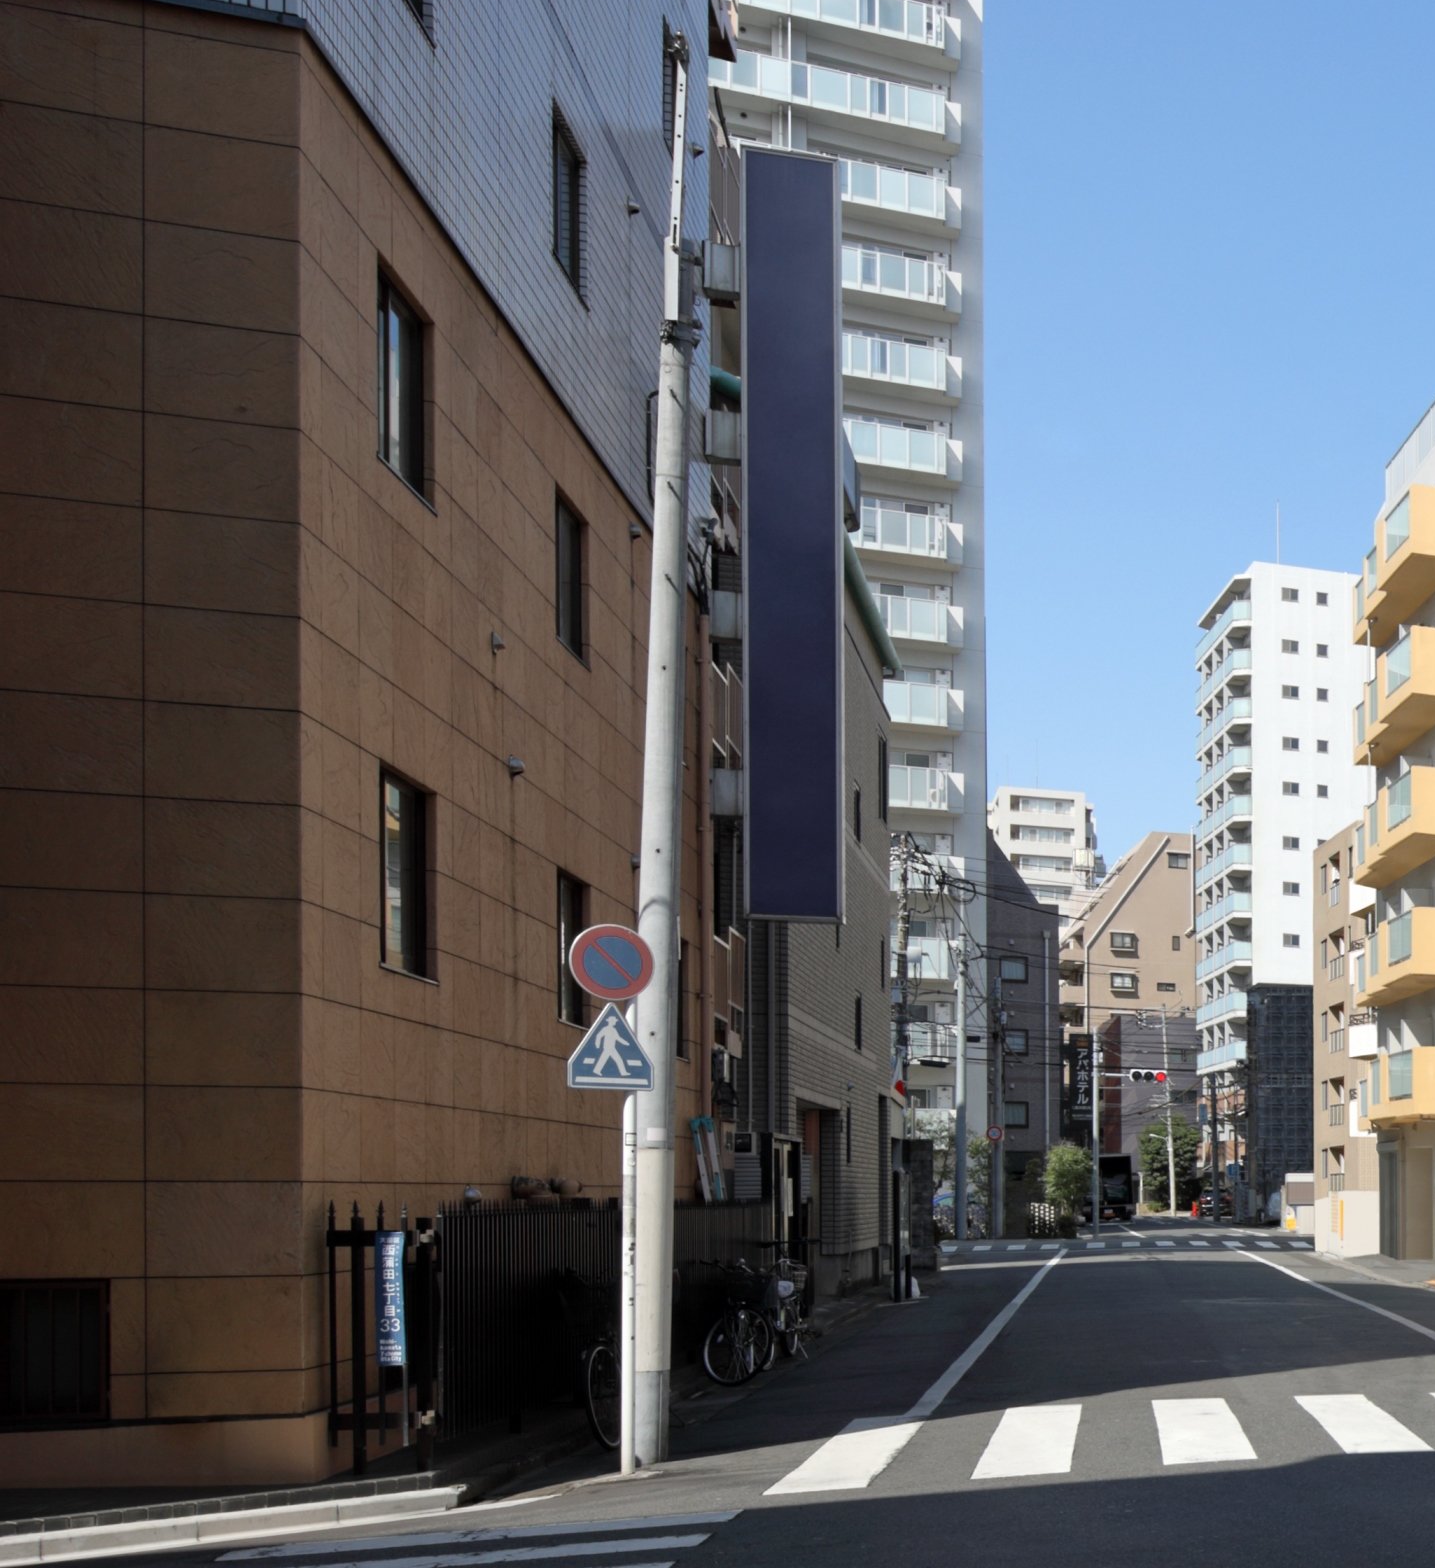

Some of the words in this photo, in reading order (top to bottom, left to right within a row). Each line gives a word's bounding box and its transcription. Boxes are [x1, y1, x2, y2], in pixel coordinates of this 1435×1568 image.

[1075, 1047, 1090, 1105] アパホテル
[380, 1318, 400, 1332] 33
